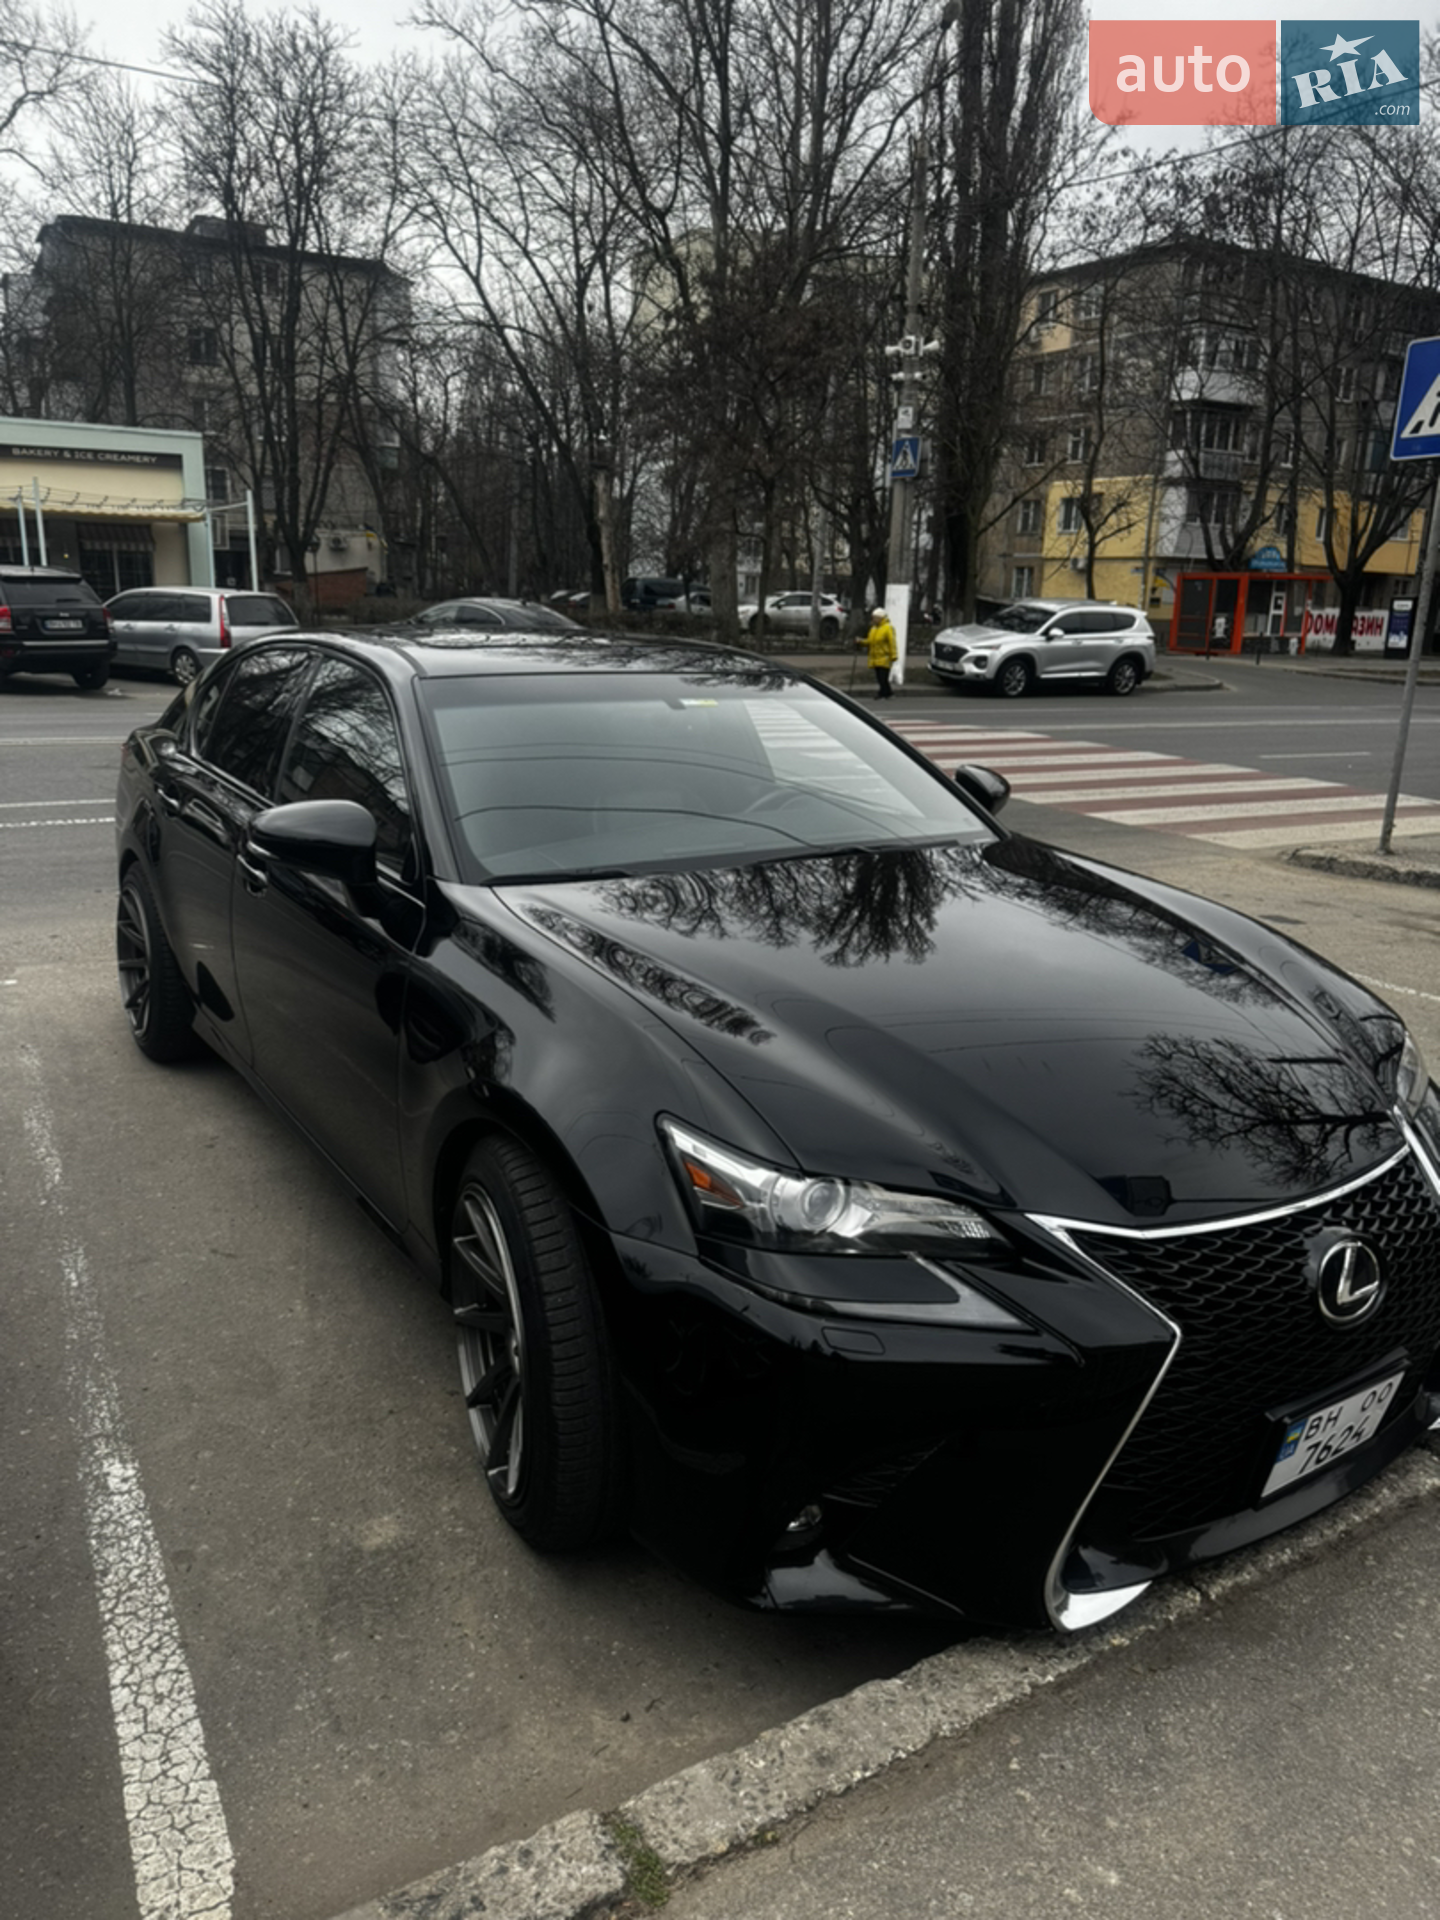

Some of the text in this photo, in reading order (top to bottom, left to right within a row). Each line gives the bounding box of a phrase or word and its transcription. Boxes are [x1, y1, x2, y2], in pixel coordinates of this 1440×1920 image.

[11, 447, 157, 464] BAKERY & ICE CREAMERY
[1303, 1406, 1343, 1441] BH
[1297, 1415, 1371, 1475] 7624
